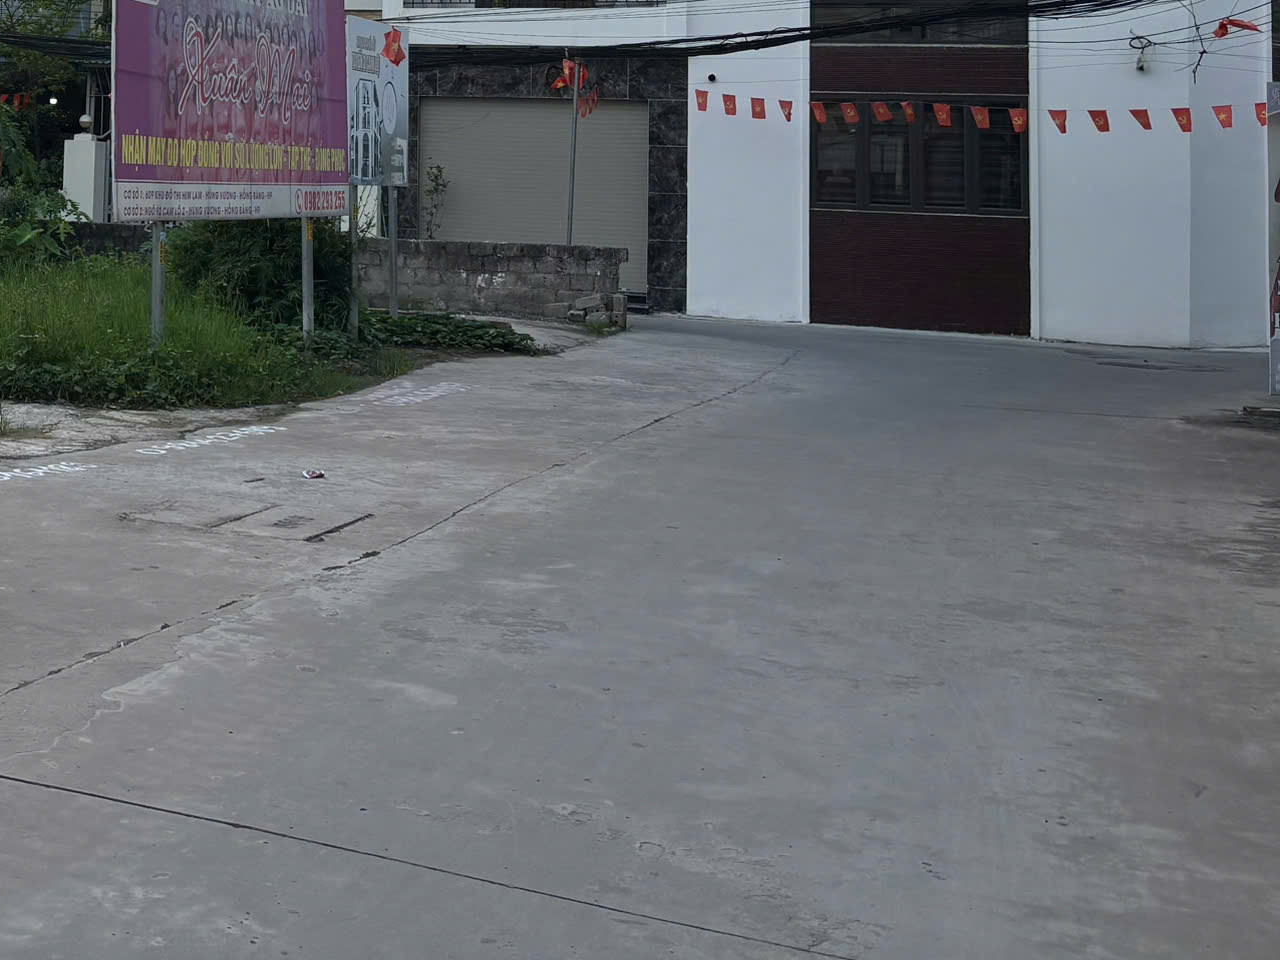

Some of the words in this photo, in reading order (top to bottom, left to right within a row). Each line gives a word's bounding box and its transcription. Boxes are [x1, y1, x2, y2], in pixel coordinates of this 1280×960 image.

[178, 16, 252, 115] Xuân
[254, 32, 312, 125] Mai
[122, 128, 146, 172] NHẬN
[148, 136, 166, 166] MAY
[180, 137, 197, 173] HỢP
[198, 131, 220, 168] ĐỒNG
[304, 190, 320, 211] 0982
